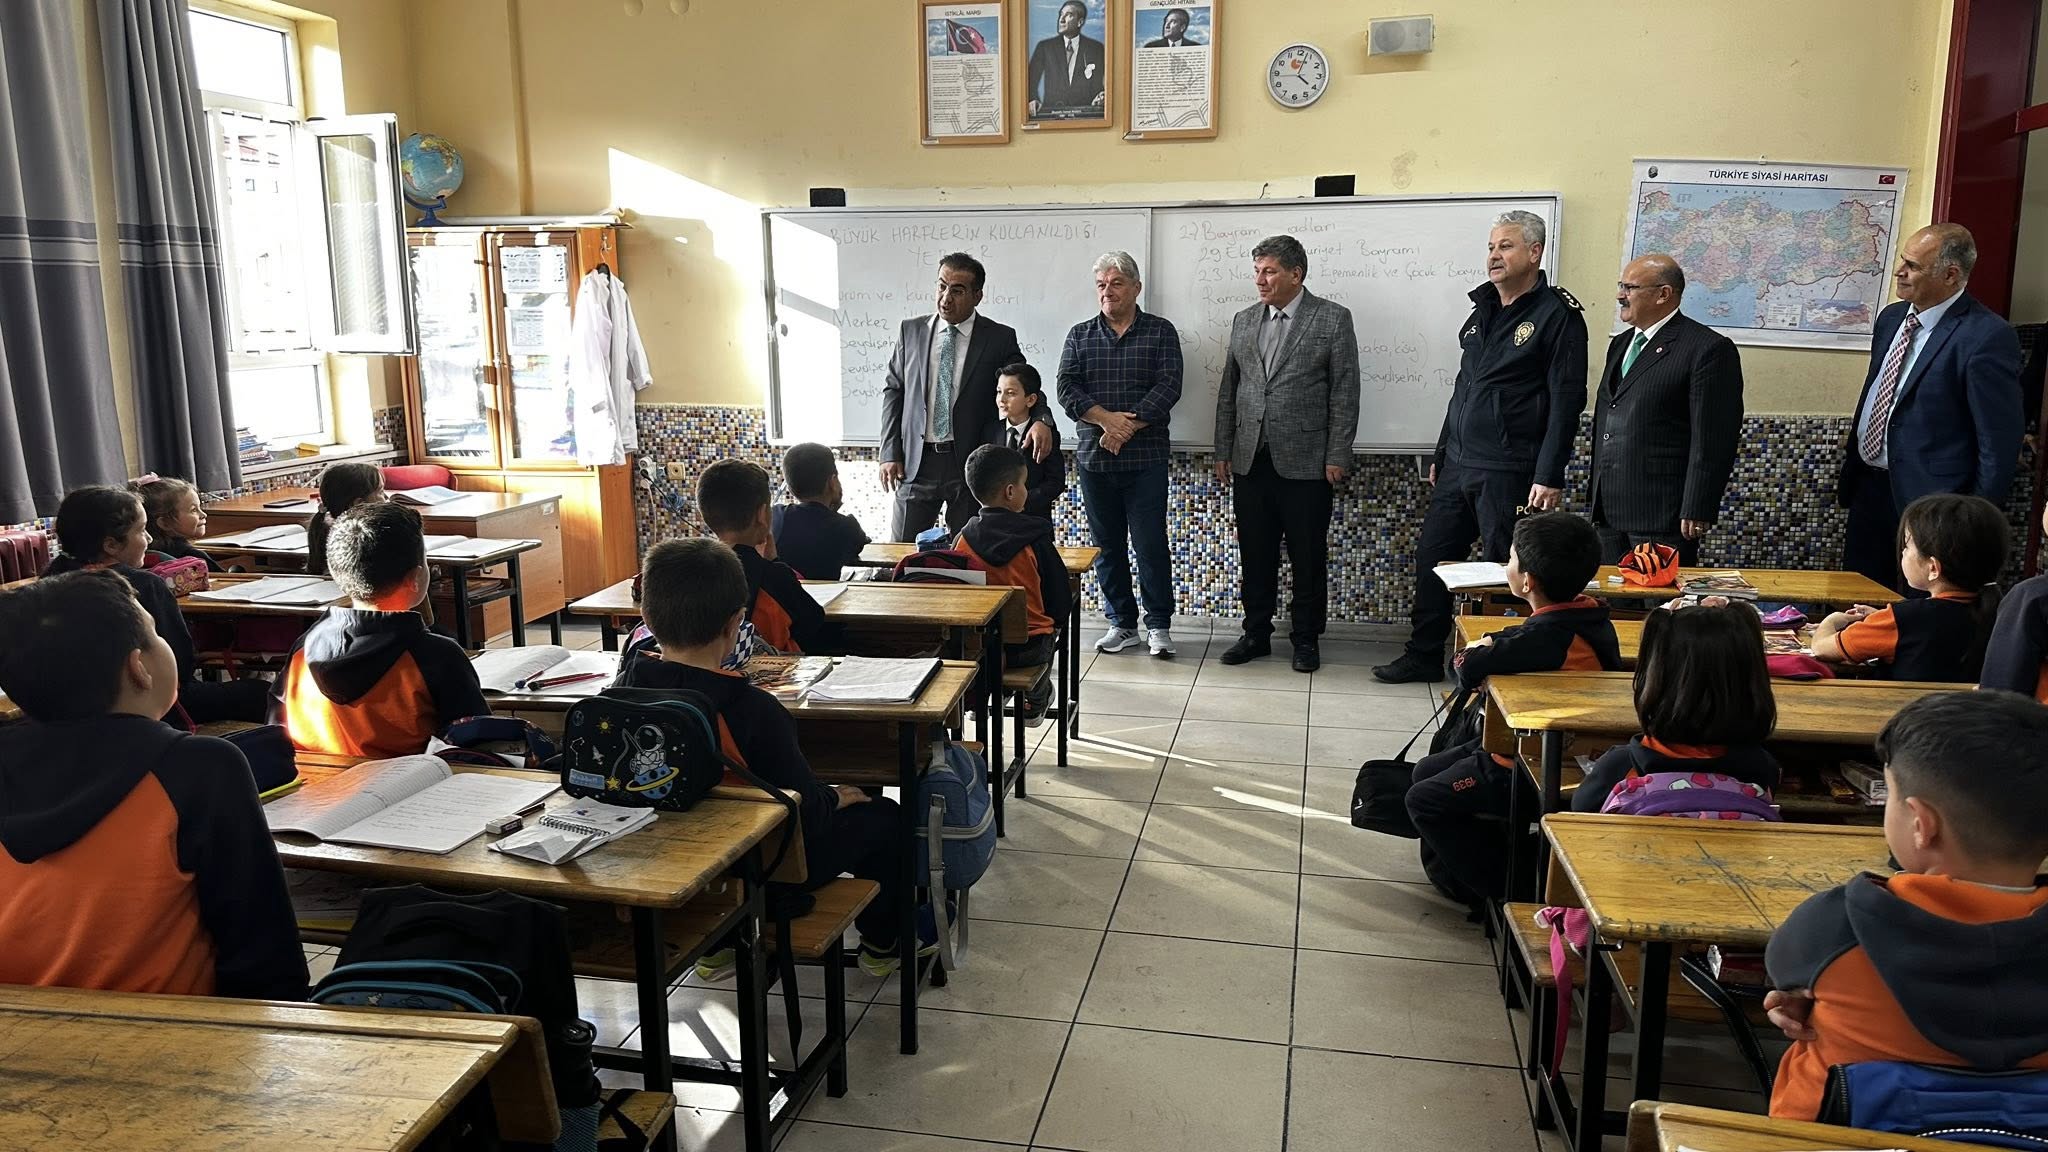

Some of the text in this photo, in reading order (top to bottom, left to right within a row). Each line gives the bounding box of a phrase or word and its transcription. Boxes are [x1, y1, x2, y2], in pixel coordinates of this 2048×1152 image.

[1708, 169, 1829, 183] TÜRKİYE SİYASİ HARİTASI
[830, 227, 881, 246] BÜYÜK
[891, 224, 981, 242] HARFLERİN
[1198, 247, 1222, 263] 29
[1226, 247, 1252, 260] Eki
[1305, 242, 1343, 262] uriyet
[1198, 267, 1224, 282] 23
[1444, 260, 1487, 284] Bayra
[981, 285, 1020, 305] dları
[1202, 284, 1261, 305] Ramaza
[832, 308, 891, 331] Merkez
[1453, 777, 1477, 792] 1933
